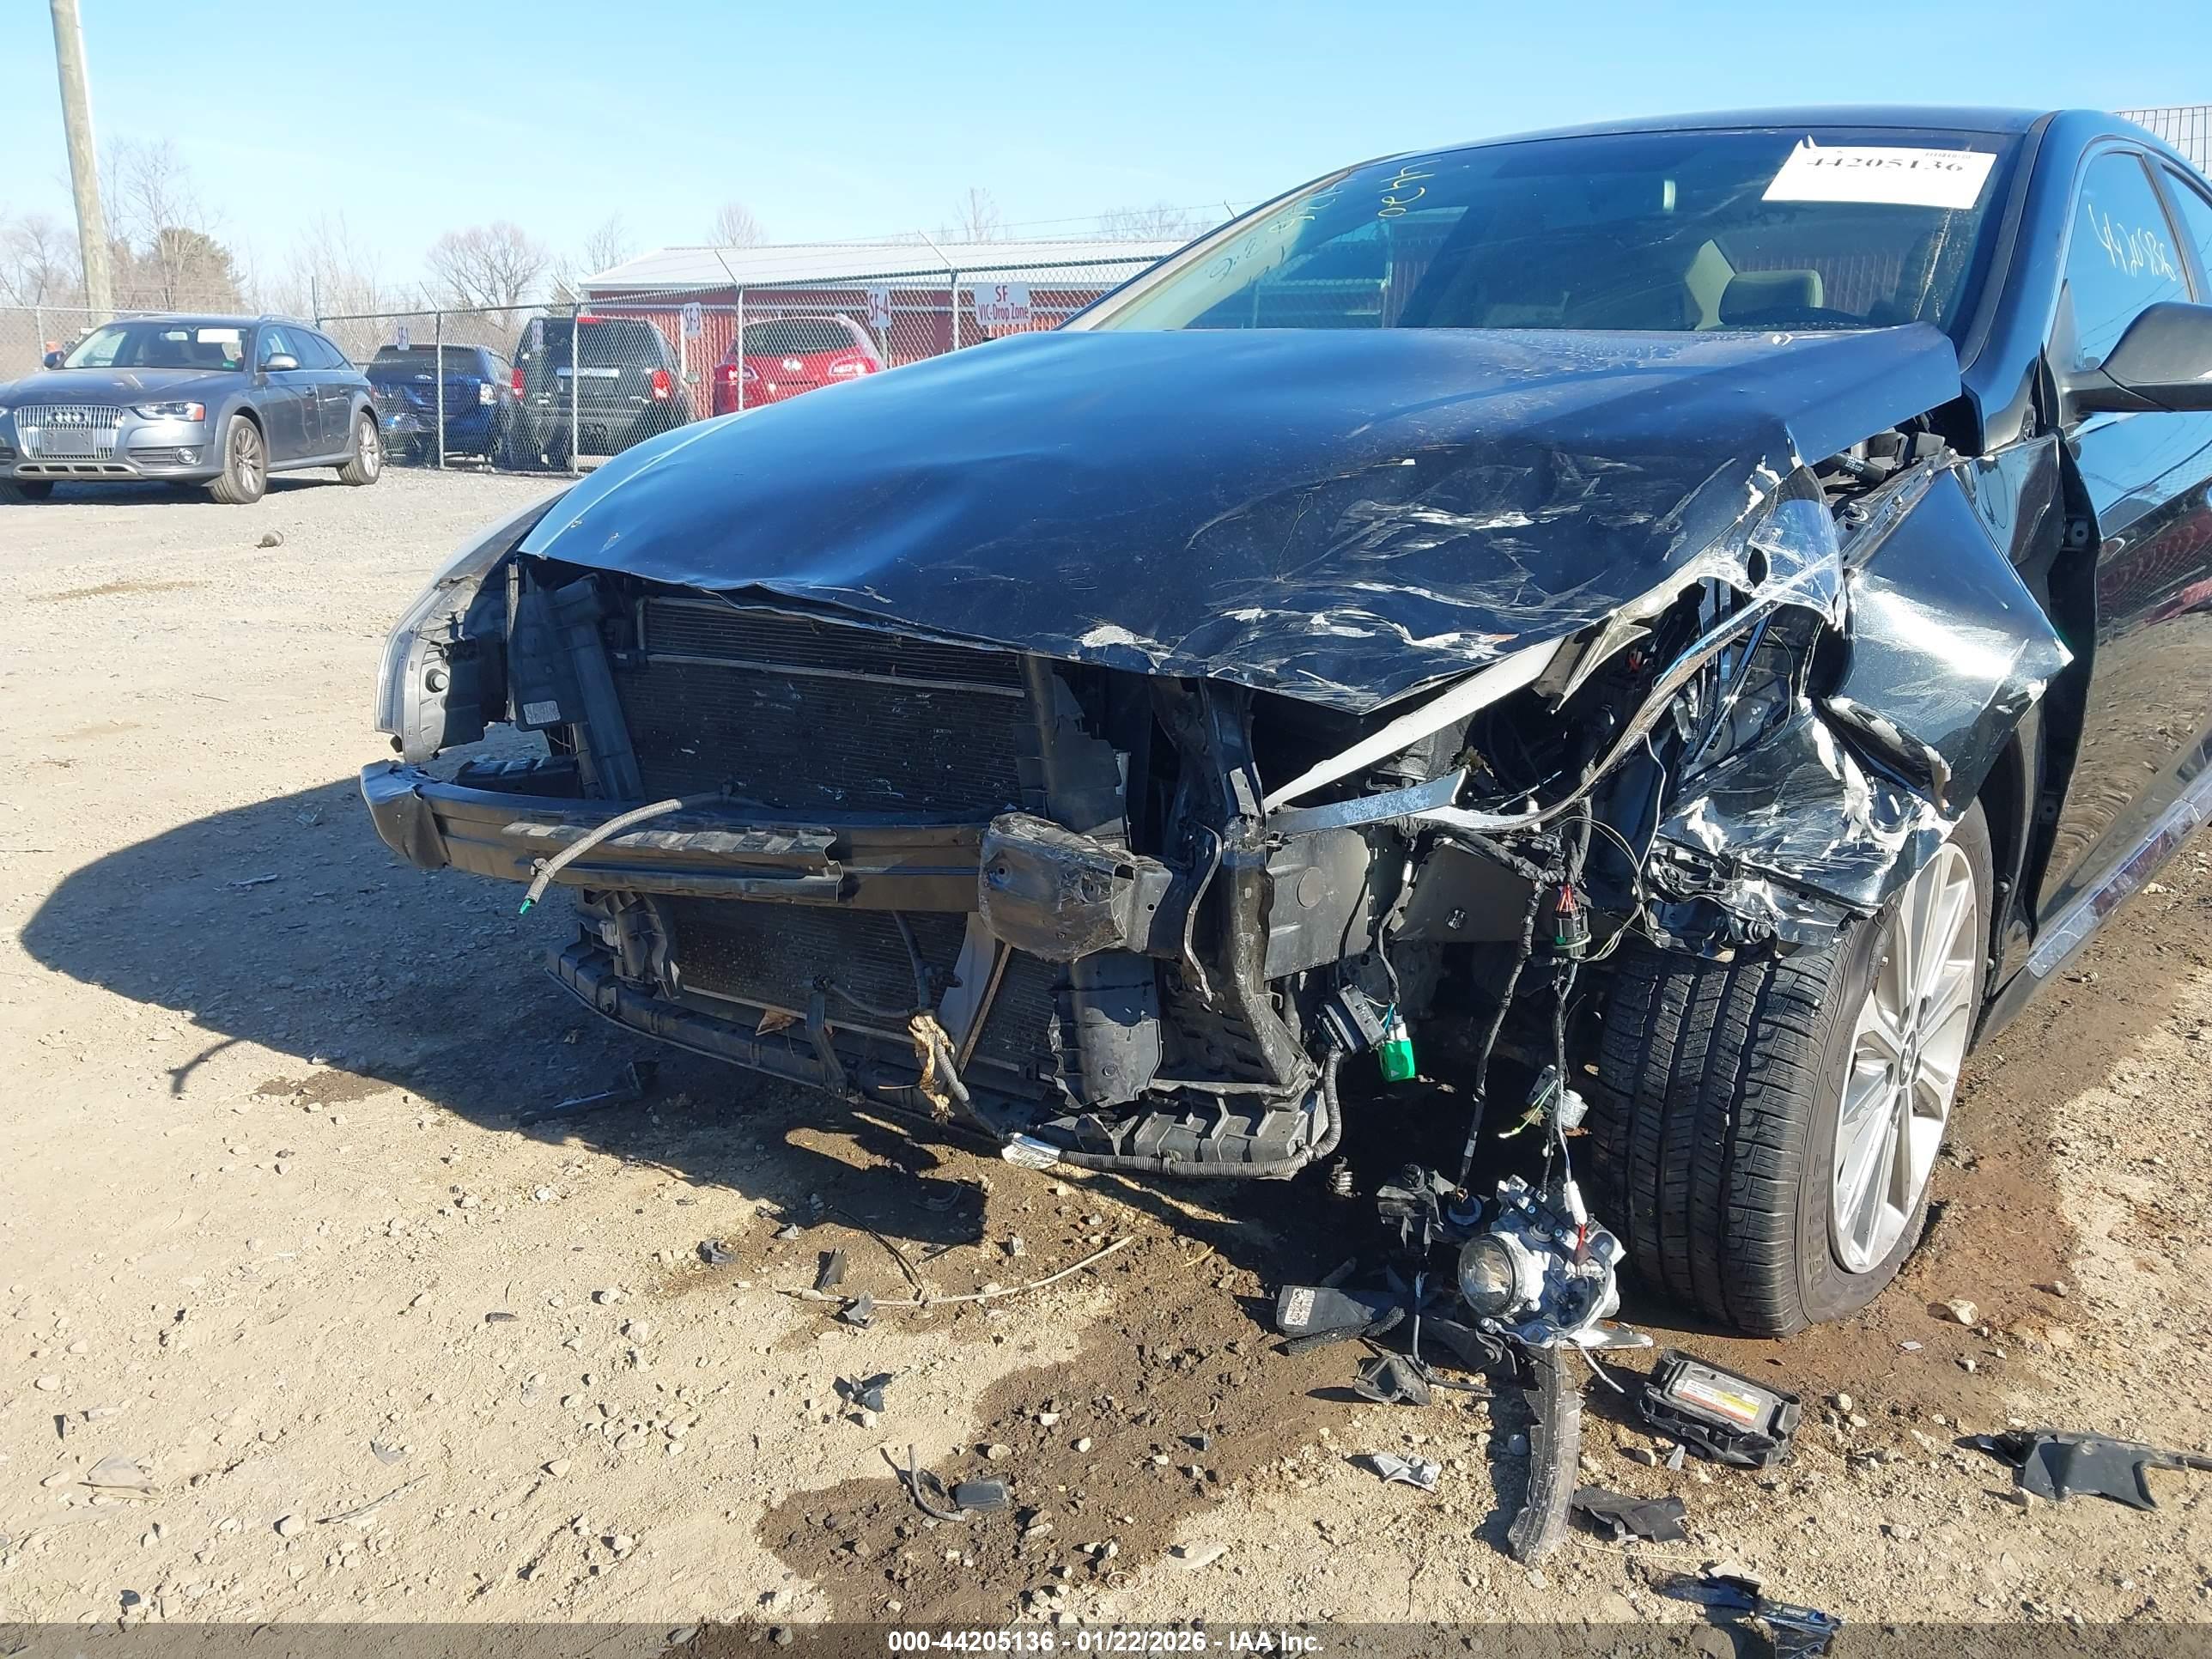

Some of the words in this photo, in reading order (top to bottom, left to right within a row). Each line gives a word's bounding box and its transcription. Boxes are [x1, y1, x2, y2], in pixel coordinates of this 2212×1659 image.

[1807, 157, 1964, 173] 44205136
[995, 284, 1008, 302] SF
[868, 293, 890, 321] SF-4
[1010, 302, 1030, 319] Zone
[685, 307, 701, 332] SF-3
